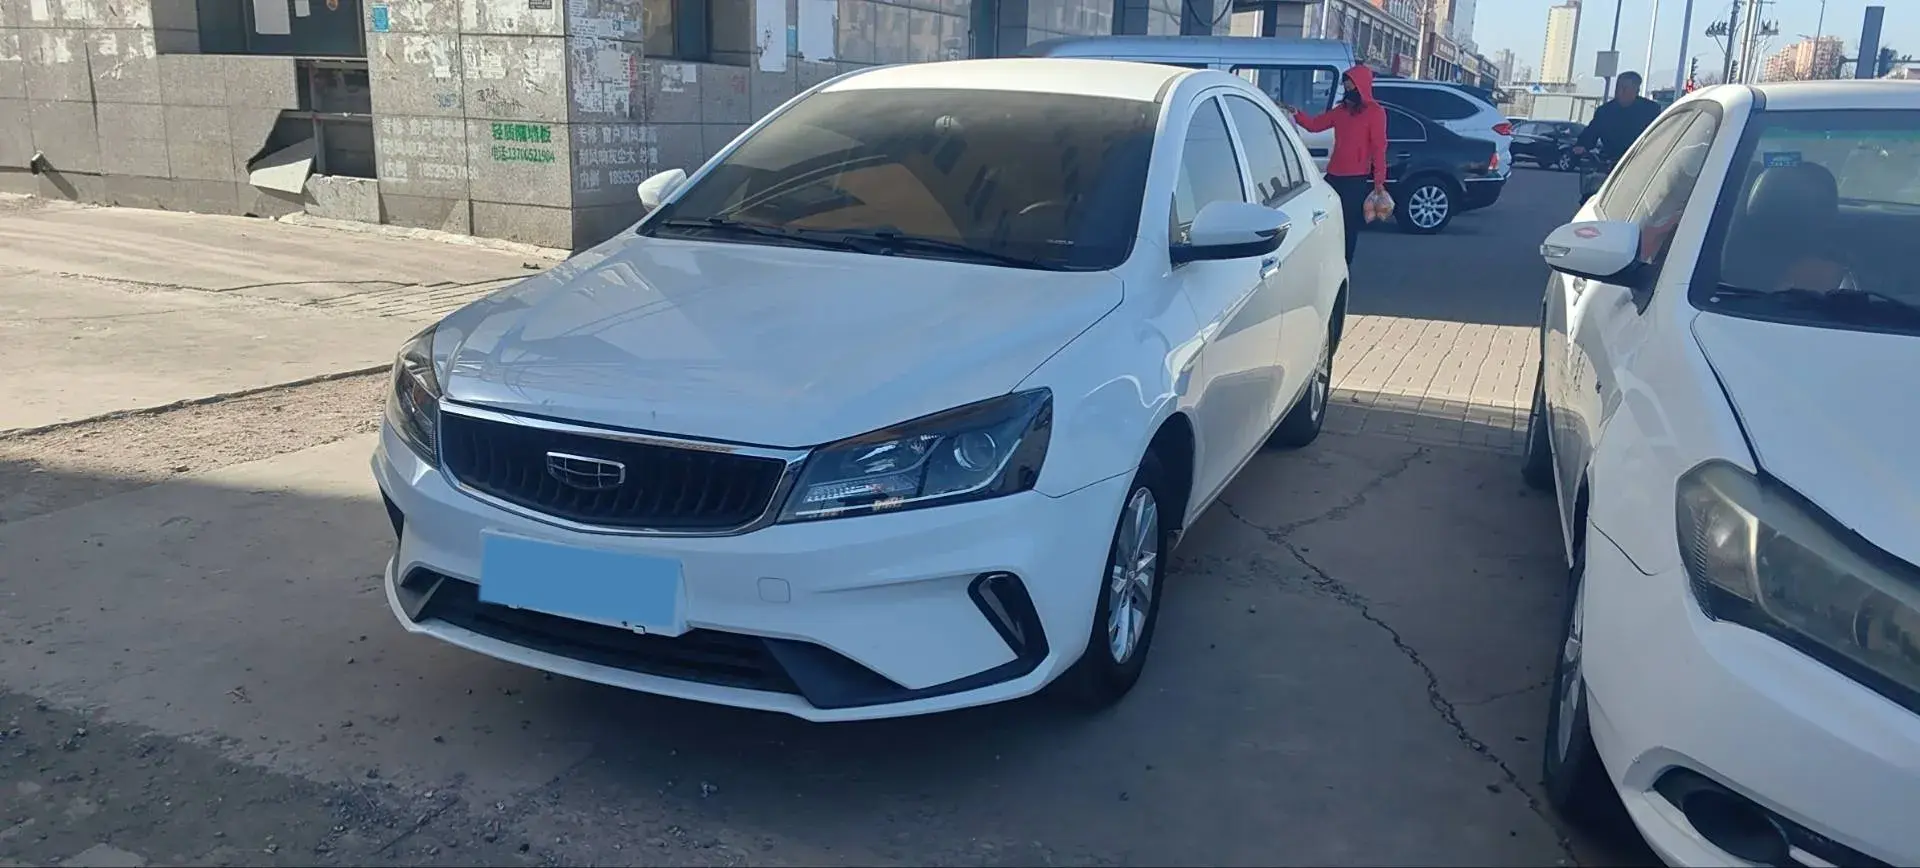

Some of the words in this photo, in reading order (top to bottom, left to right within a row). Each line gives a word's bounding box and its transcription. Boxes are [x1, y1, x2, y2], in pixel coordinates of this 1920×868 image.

[491, 123, 552, 143] 轻质隔墙板
